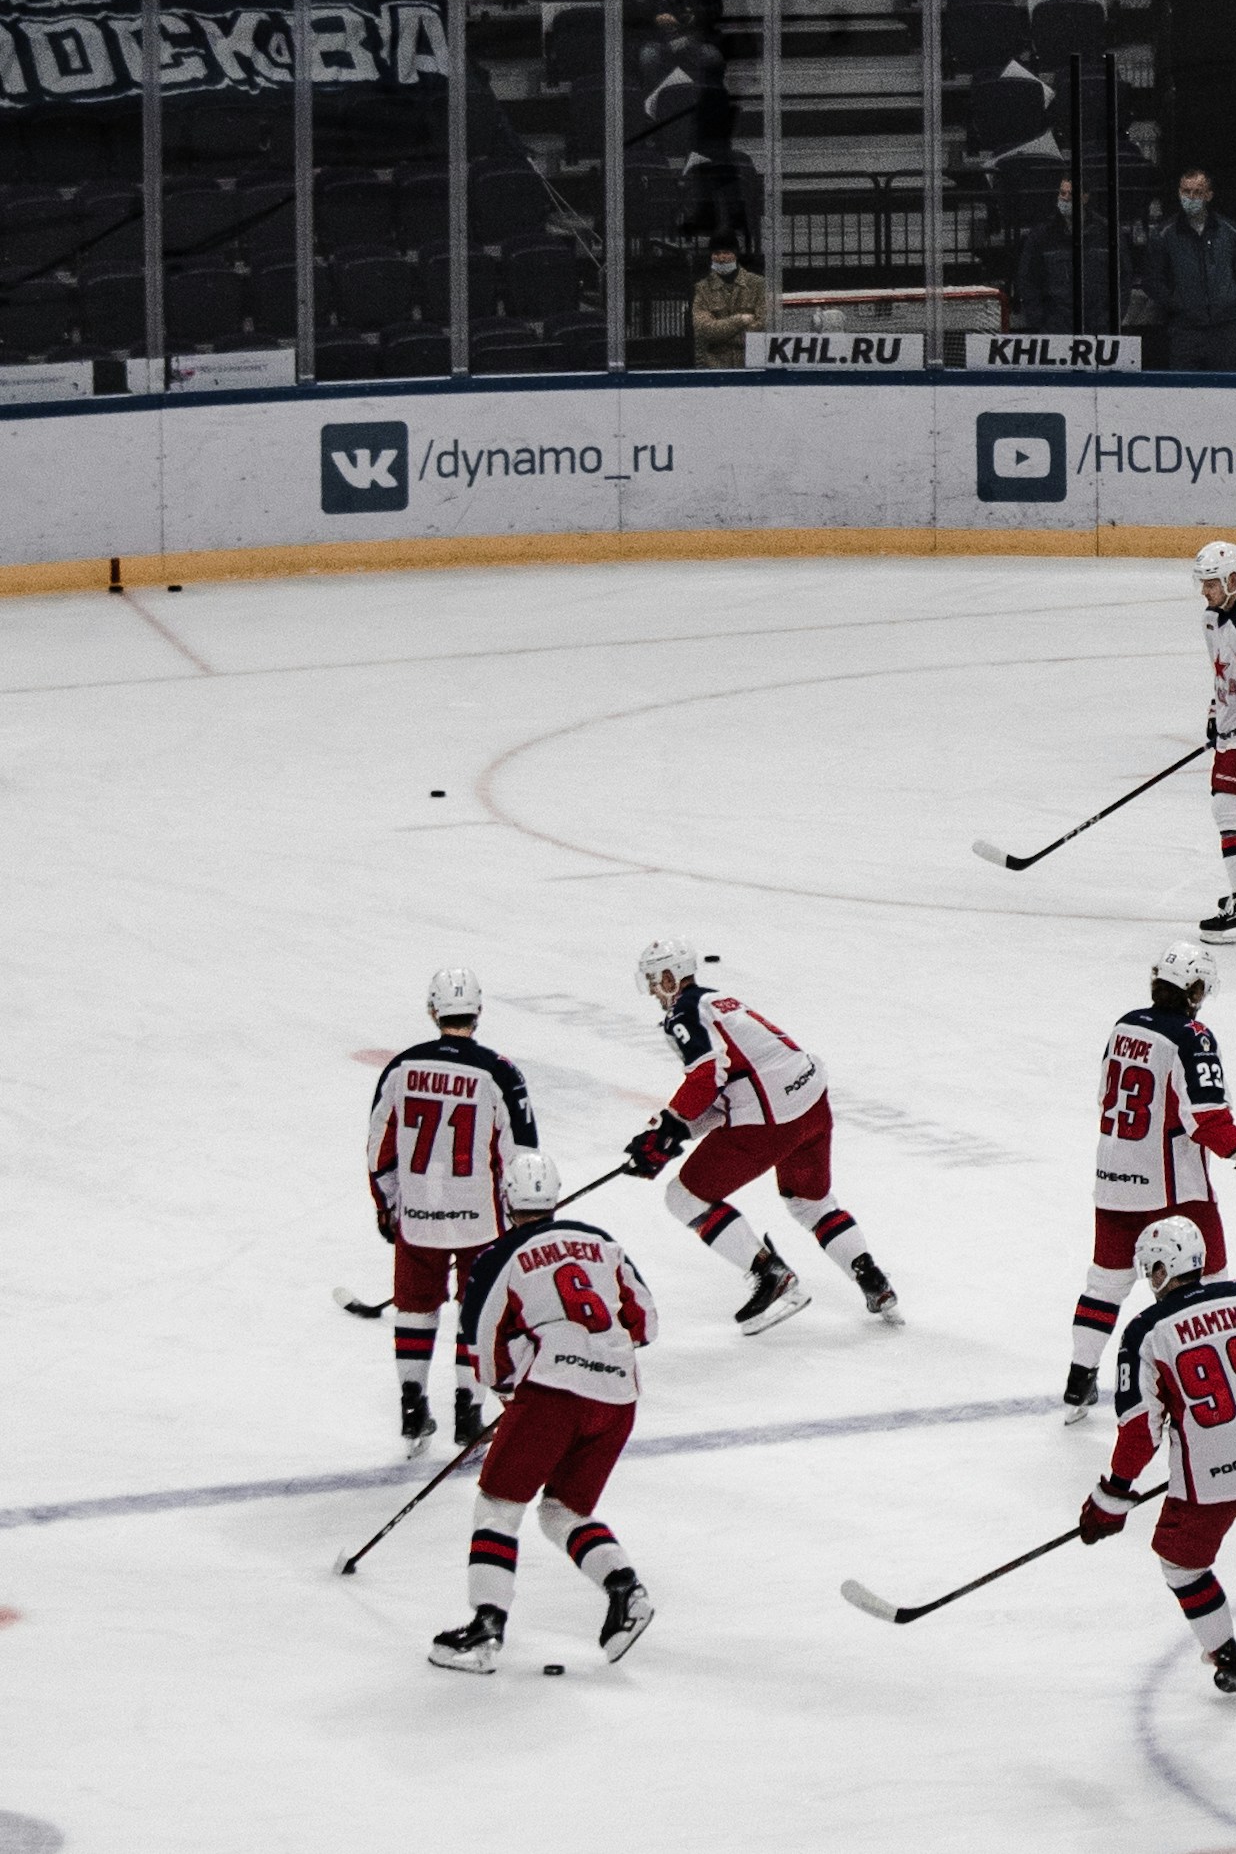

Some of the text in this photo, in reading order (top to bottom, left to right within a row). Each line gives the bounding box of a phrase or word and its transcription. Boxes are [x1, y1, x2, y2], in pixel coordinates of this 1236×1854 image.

[767, 336, 902, 365] KHL.RU
[987, 338, 1121, 366] KHL.RU
[420, 439, 675, 487] /dynamo_ru
[407, 1070, 478, 1099] OKULOV
[1196, 1062, 1224, 1089] 23
[1100, 1059, 1156, 1141] 23
[403, 1096, 478, 1177] 71
[1096, 1168, 1150, 1185] СНЕФТЬ
[404, 1206, 480, 1220] ОСНЕФТЬ
[553, 1262, 613, 1334] 6
[1116, 1362, 1131, 1392] 8
